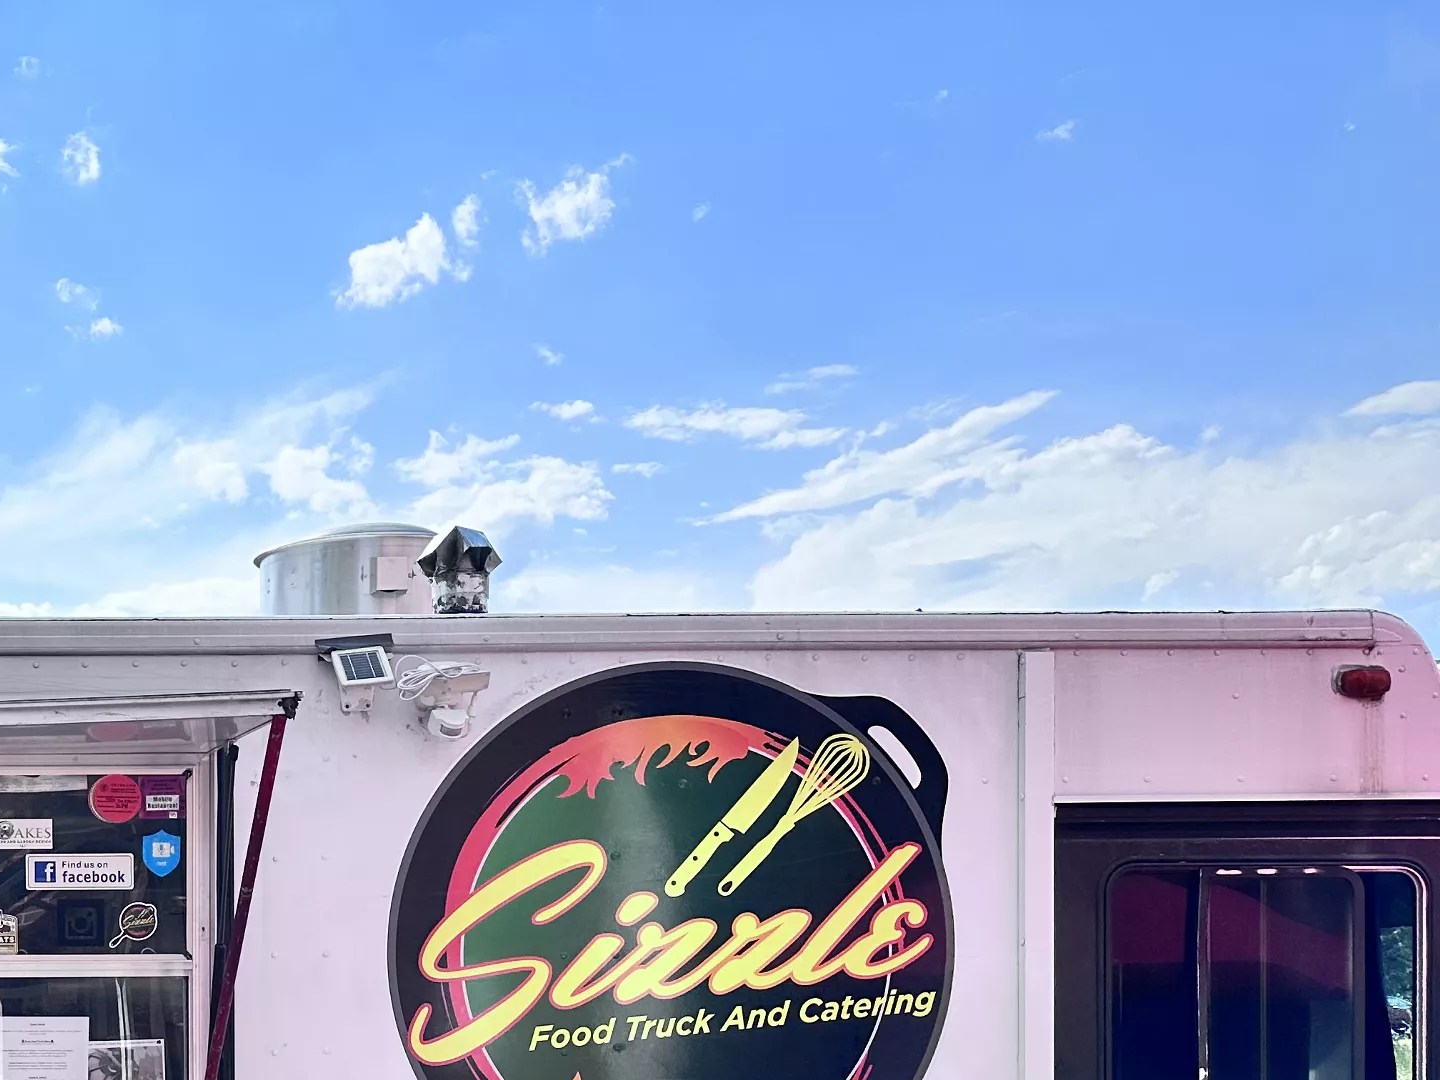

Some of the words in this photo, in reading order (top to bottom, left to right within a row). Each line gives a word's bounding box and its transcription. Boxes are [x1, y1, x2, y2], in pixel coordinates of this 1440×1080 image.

[61, 861, 82, 869] Find
[61, 870, 126, 884] facebook
[408, 838, 935, 1067] Sizzle
[528, 1018, 615, 1052] Food
[625, 1010, 711, 1043] Truck
[720, 1003, 789, 1033] And
[798, 989, 937, 1025] Catering
